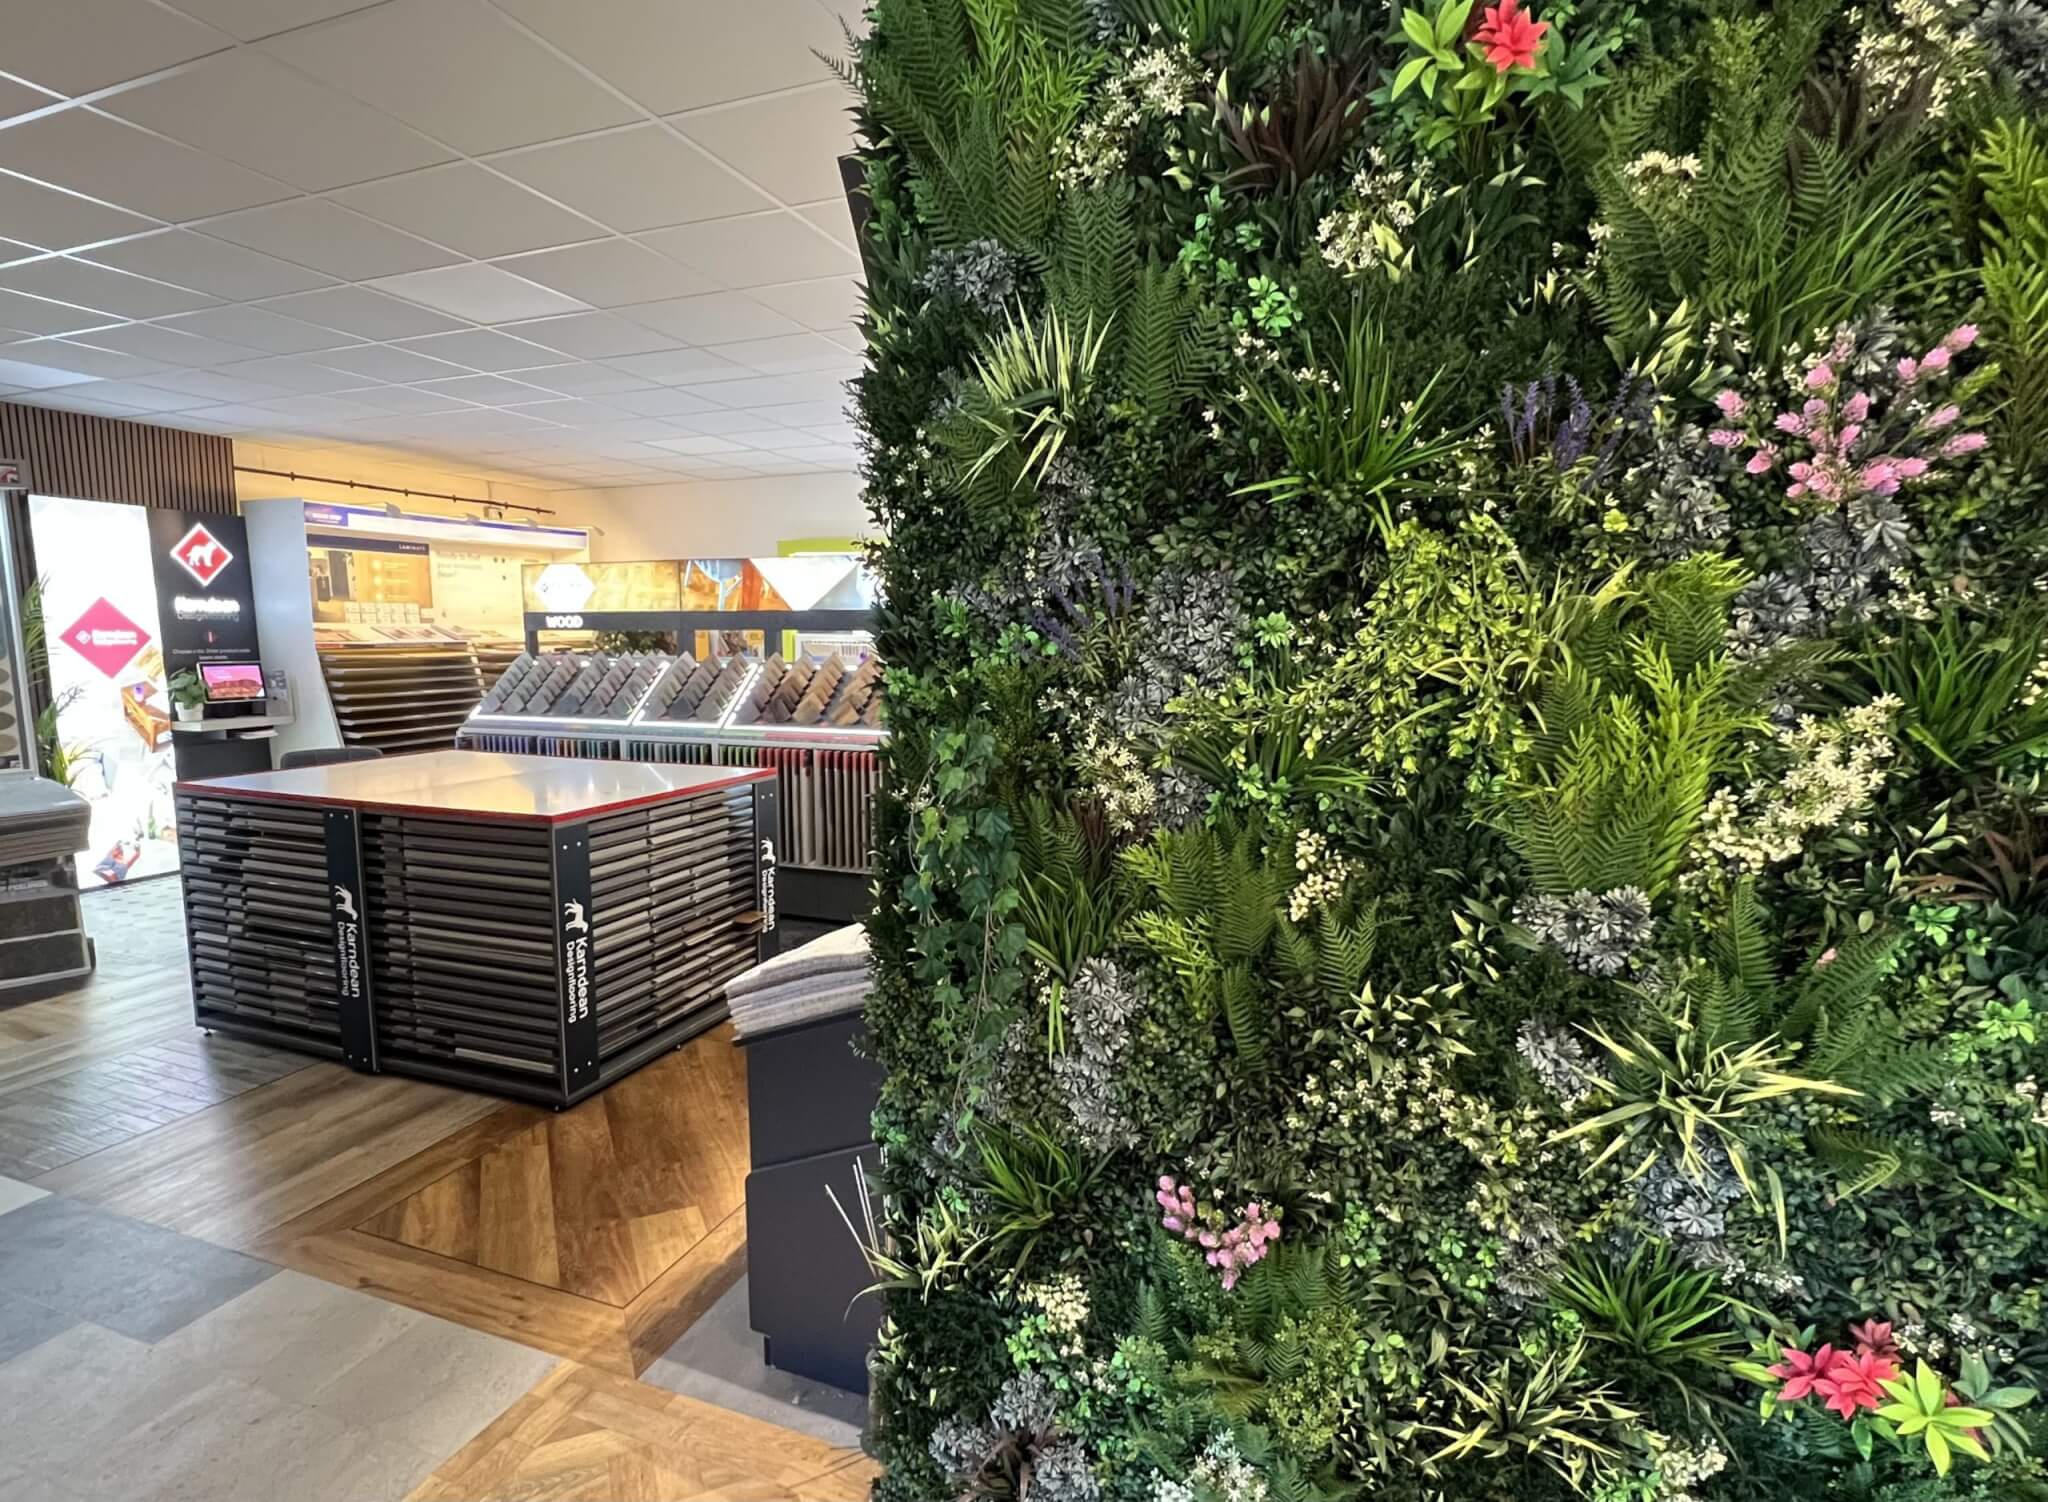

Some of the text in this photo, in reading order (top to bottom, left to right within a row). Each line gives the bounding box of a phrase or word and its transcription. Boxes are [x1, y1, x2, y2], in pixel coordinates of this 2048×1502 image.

[545, 614, 584, 629] WOOD
[346, 922, 360, 998] Karndean
[565, 940, 577, 1024] Designflooring
[576, 936, 589, 1020] Karndean
